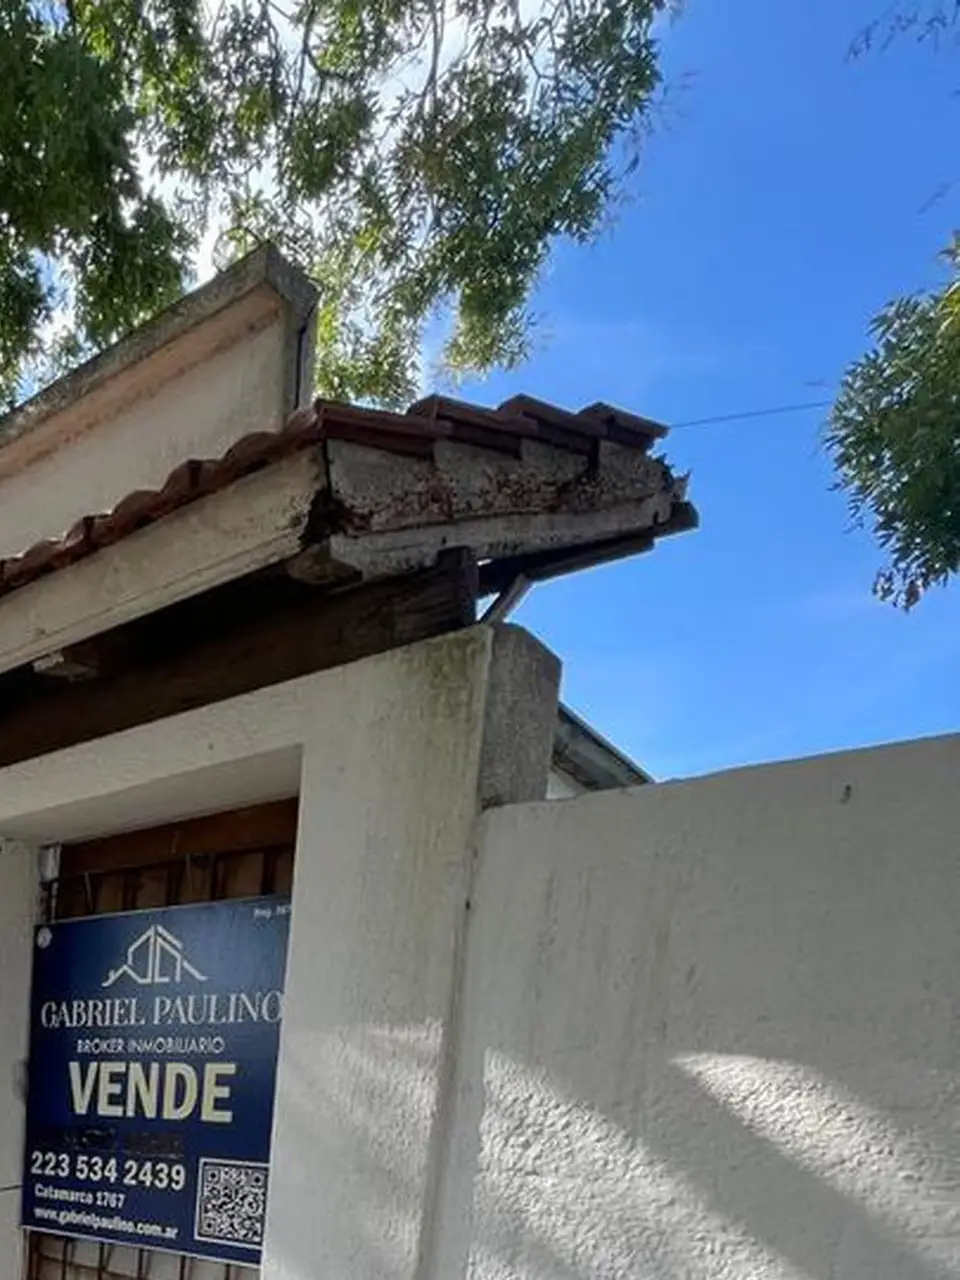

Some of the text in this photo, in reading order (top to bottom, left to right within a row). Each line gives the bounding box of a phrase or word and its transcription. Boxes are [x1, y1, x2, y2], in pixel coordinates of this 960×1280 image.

[41, 990, 284, 1029] GABRIEL PAULINO
[77, 1035, 226, 1054] BROKER INMOBILIARIO
[68, 1061, 237, 1123] VENDE
[31, 1151, 186, 1191] 223 534 2439
[96, 1190, 126, 1209] 1767
